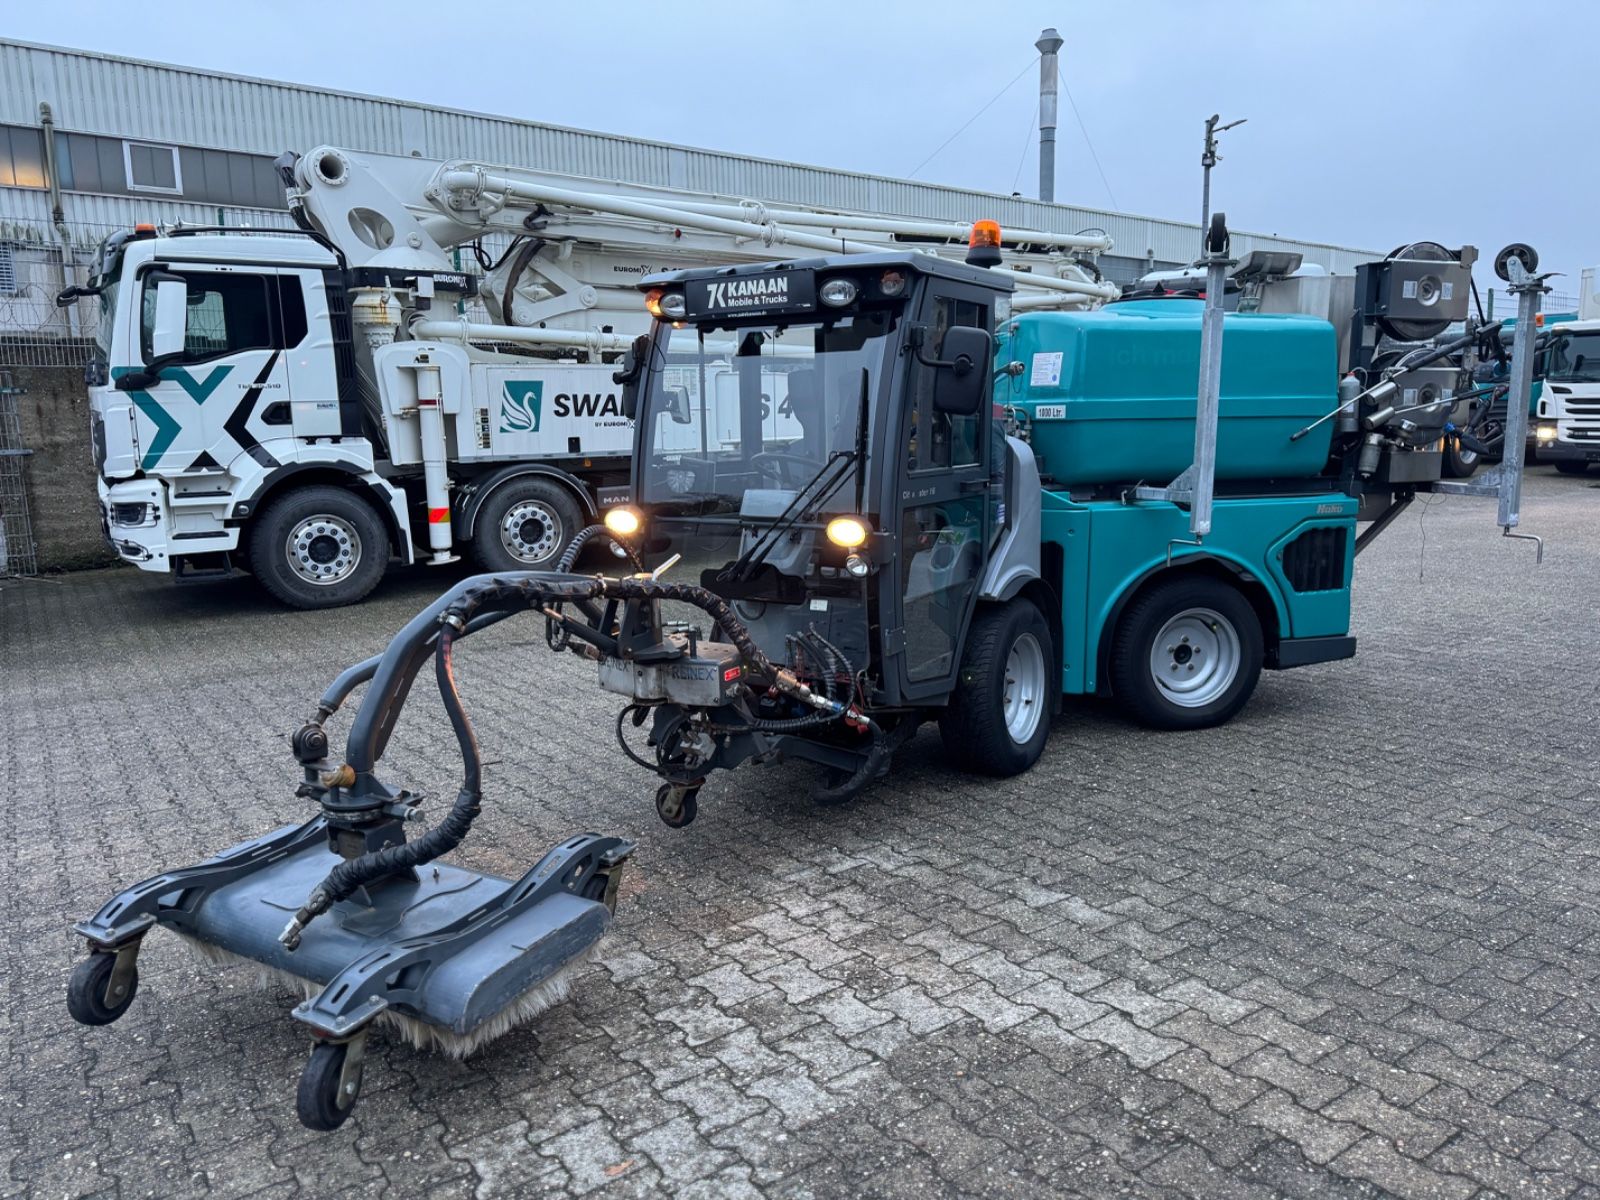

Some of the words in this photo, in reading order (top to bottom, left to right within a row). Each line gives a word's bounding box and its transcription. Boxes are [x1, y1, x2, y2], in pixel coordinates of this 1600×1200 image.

[727, 277, 788, 297] KANAAN
[727, 298, 753, 307] Mobile
[753, 297, 760, 305] &
[761, 295, 788, 305] Trucks
[553, 393, 624, 418] SWA
[1039, 407, 1052, 418] 1000
[603, 496, 630, 504] MAN
[671, 667, 716, 681] REINEX
